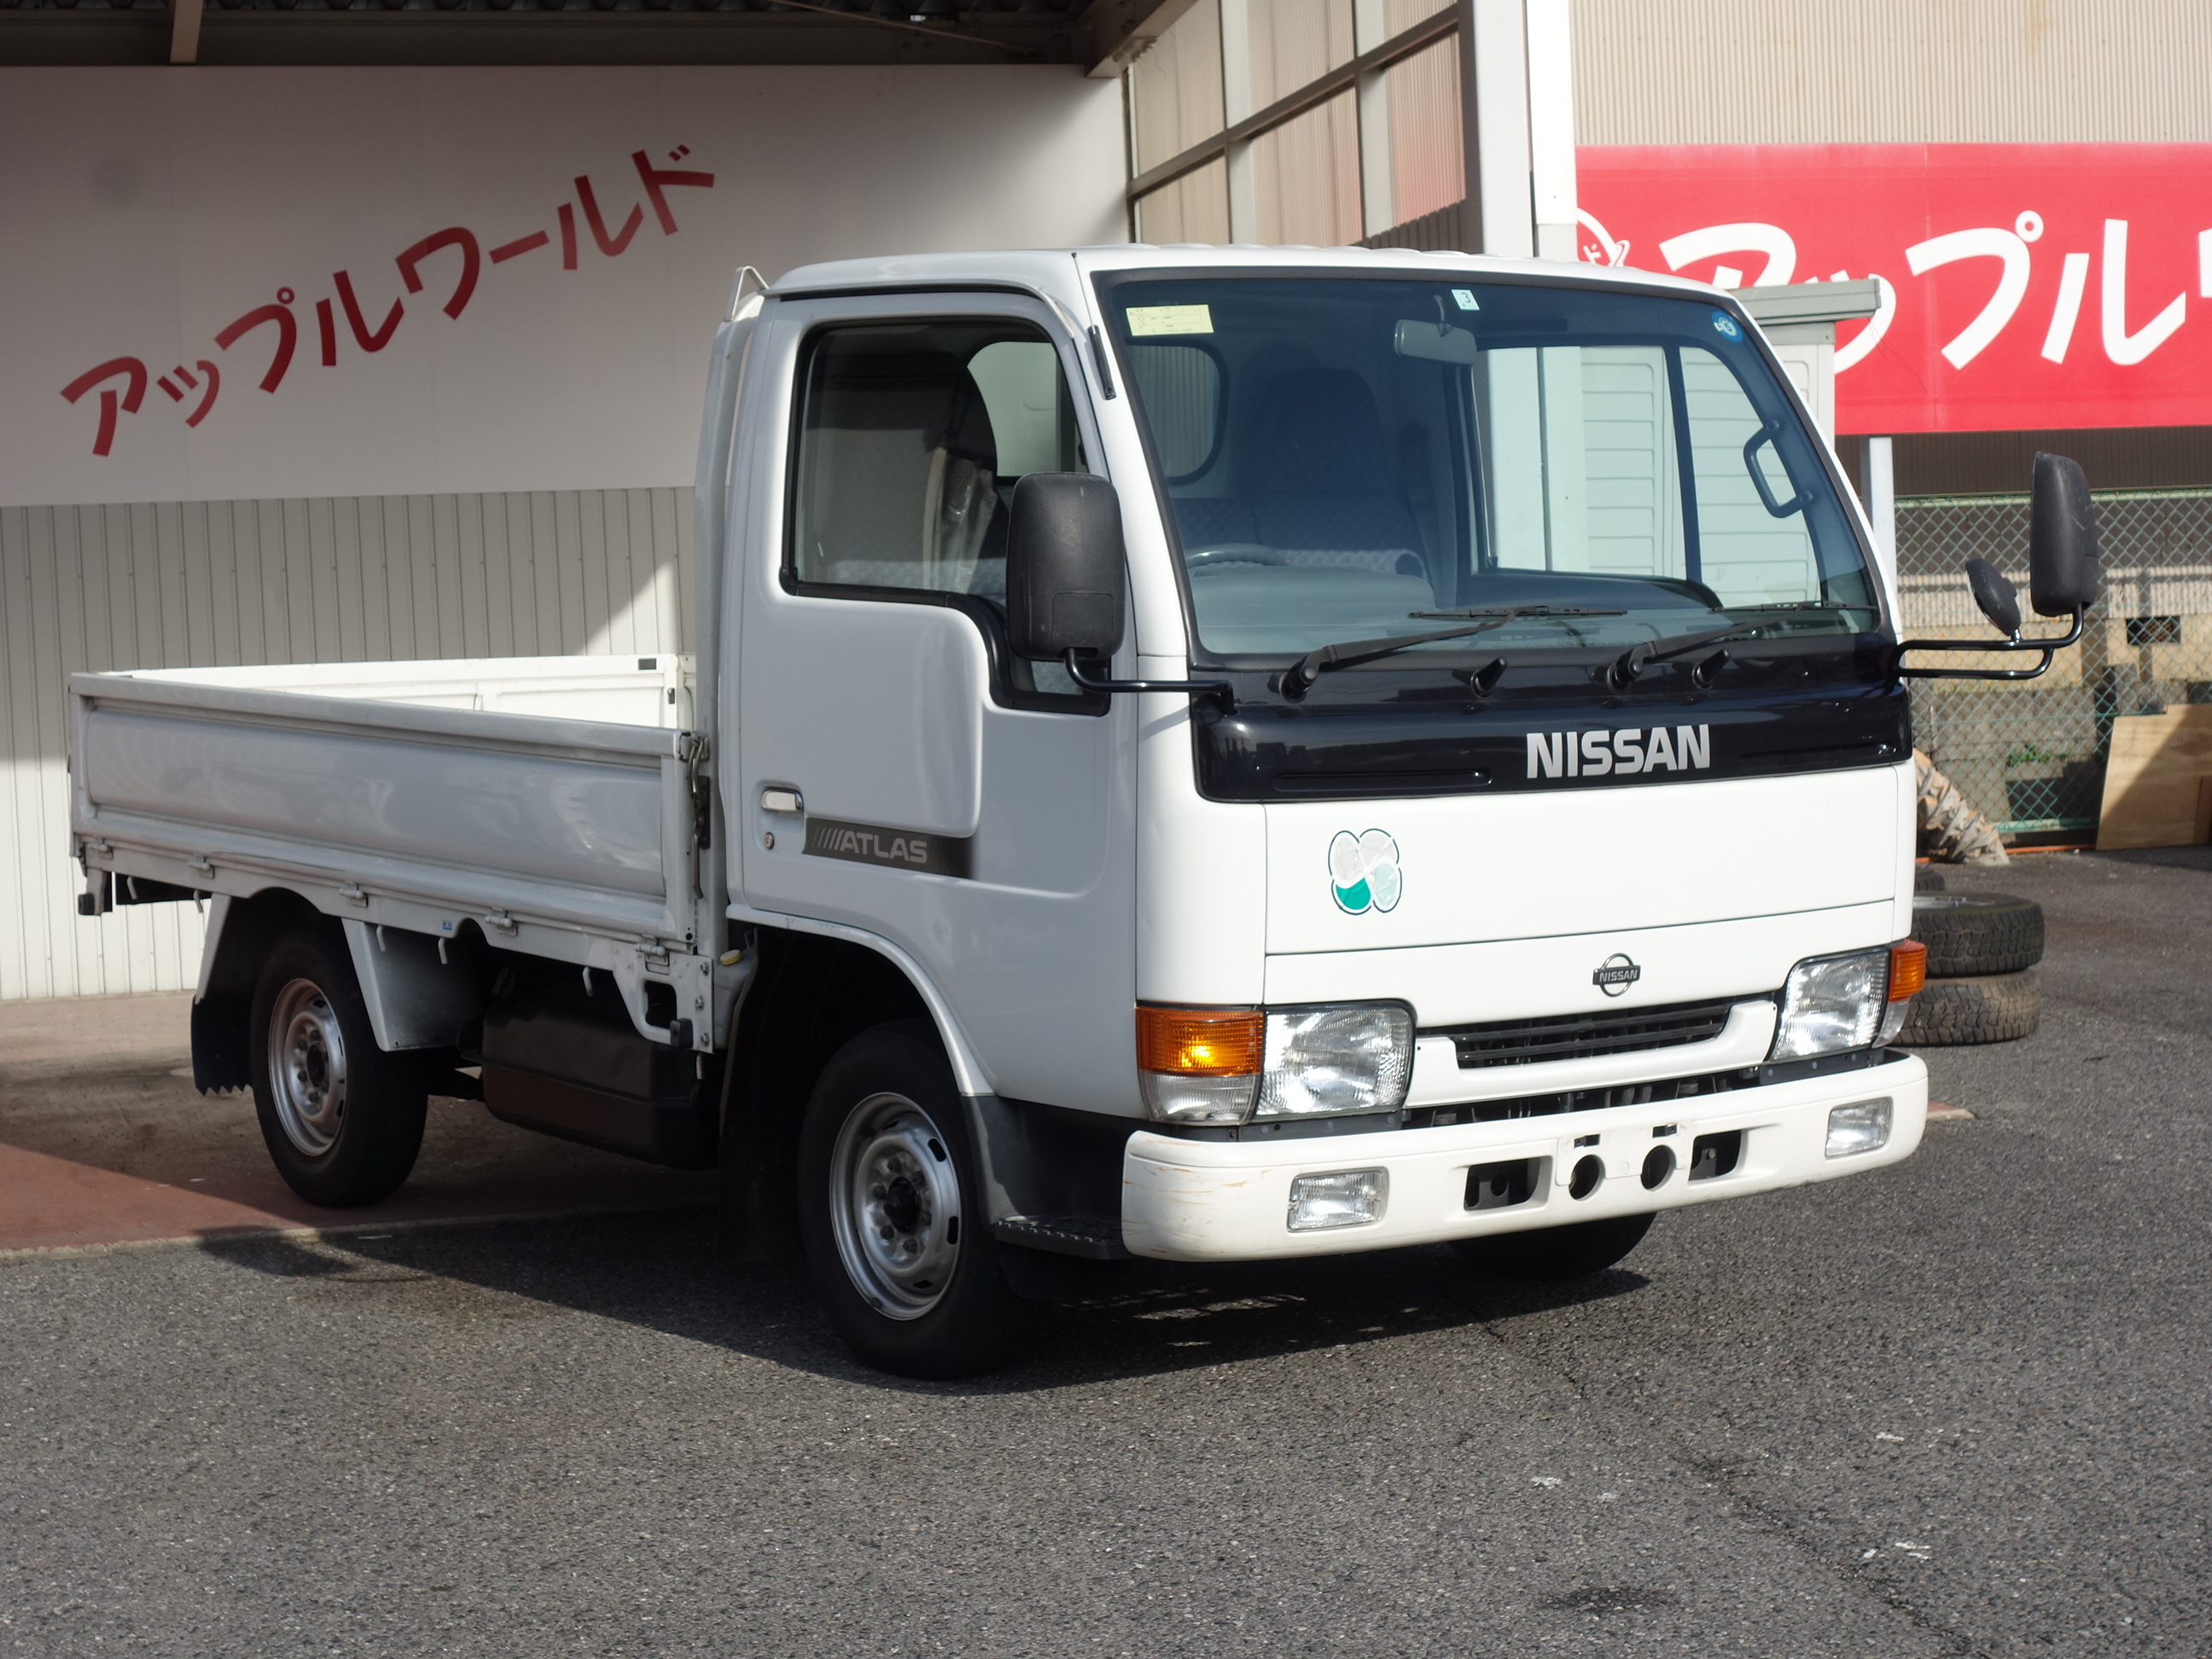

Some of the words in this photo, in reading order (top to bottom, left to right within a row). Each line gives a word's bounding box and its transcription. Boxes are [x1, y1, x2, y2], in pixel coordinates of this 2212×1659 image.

[60, 144, 714, 457] アップルワールド
[1461, 292, 1471, 303] 3
[1658, 210, 2212, 375] アップル
[1527, 724, 1710, 778] NISSAN
[840, 830, 928, 864] ATLAS
[1599, 969, 1638, 982] NISSAN
